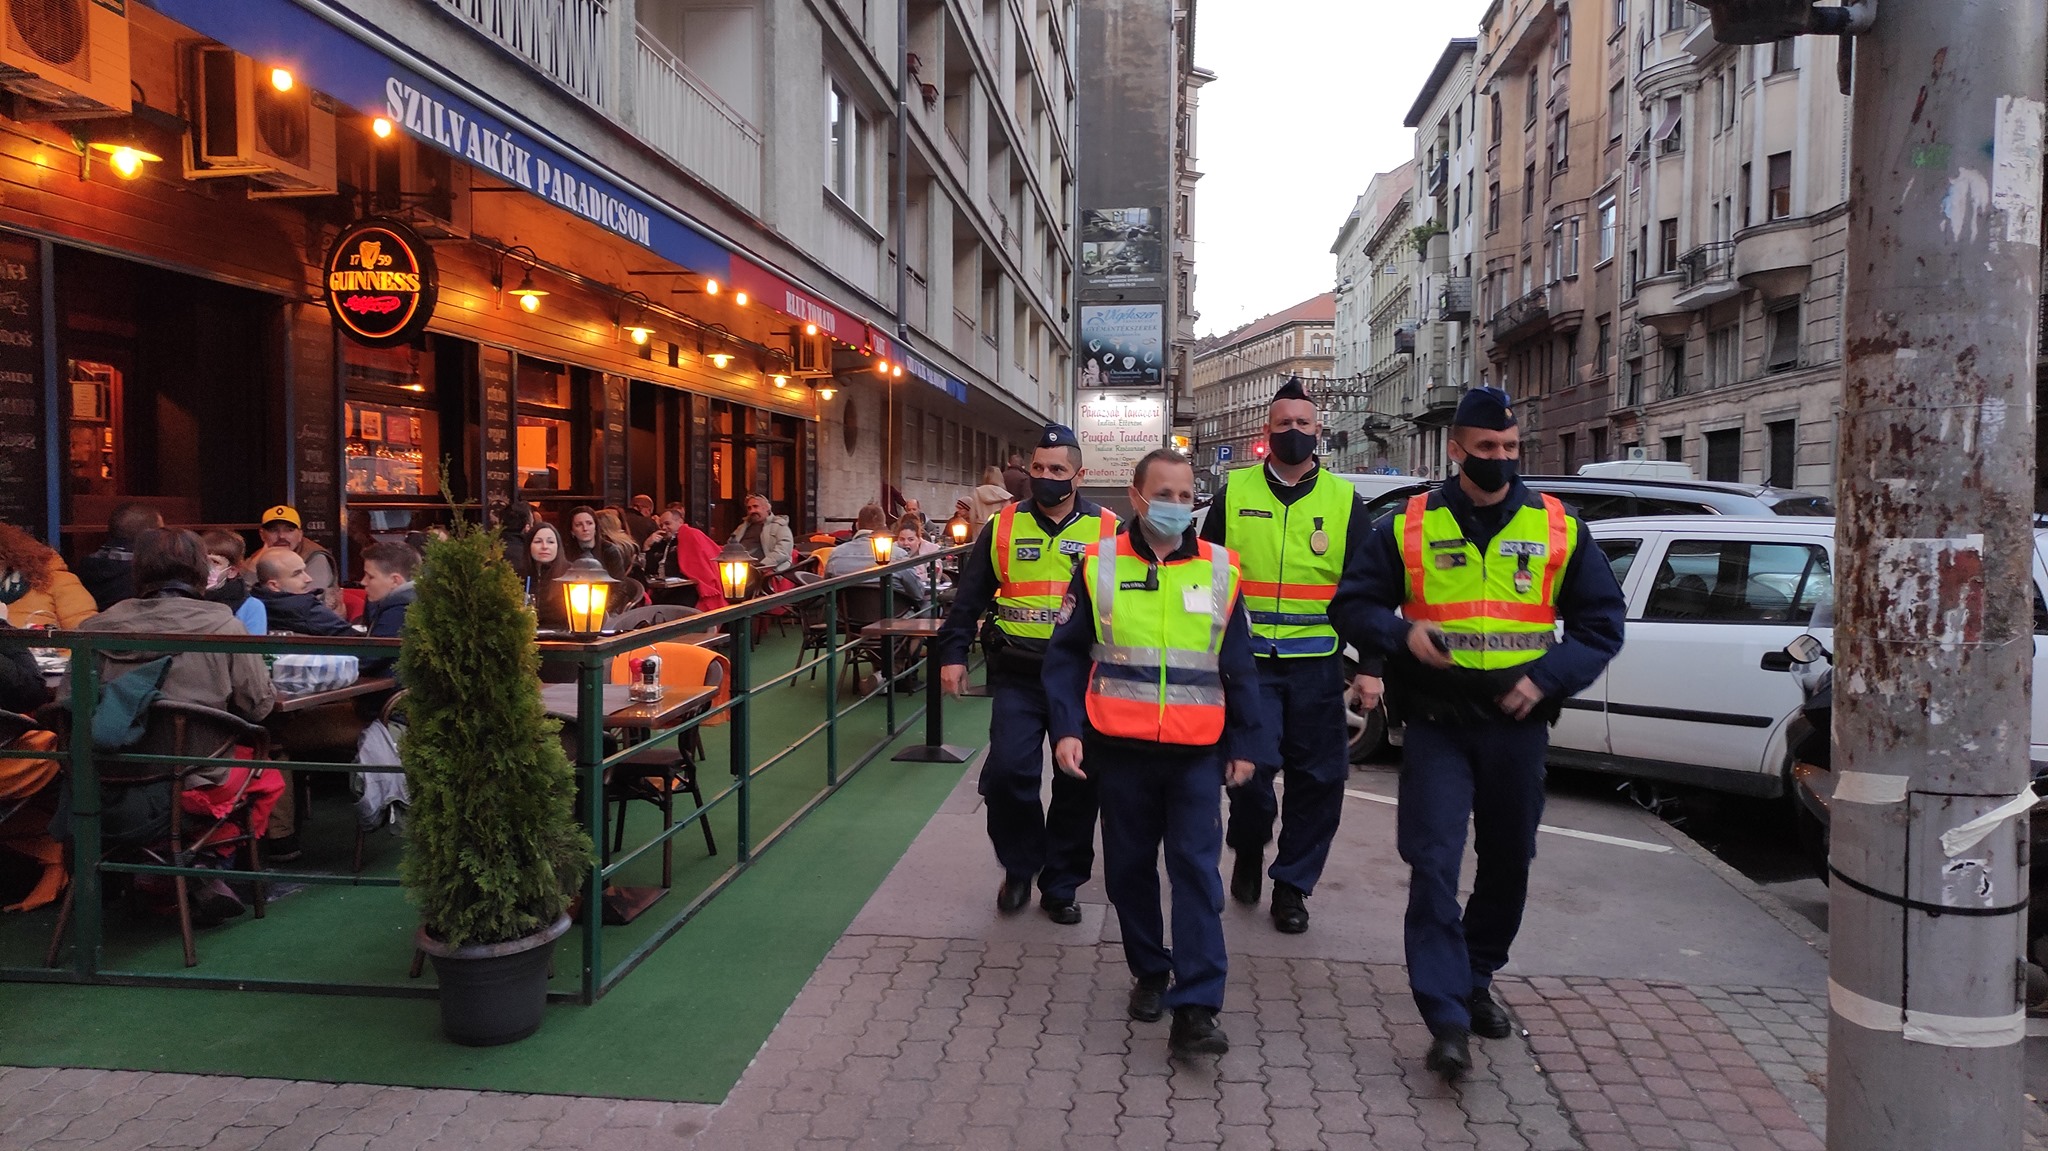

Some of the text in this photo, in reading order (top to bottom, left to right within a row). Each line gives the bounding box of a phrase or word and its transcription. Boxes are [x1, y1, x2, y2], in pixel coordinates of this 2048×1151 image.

[386, 76, 651, 247] SZILVAKÉK PARADICSOM
[349, 254, 393, 266] 17 59
[329, 270, 421, 292] GUINNESS
[786, 290, 806, 320] BLUE
[1081, 430, 1159, 444] Punjab Tandoor
[1220, 447, 1230, 459] P
